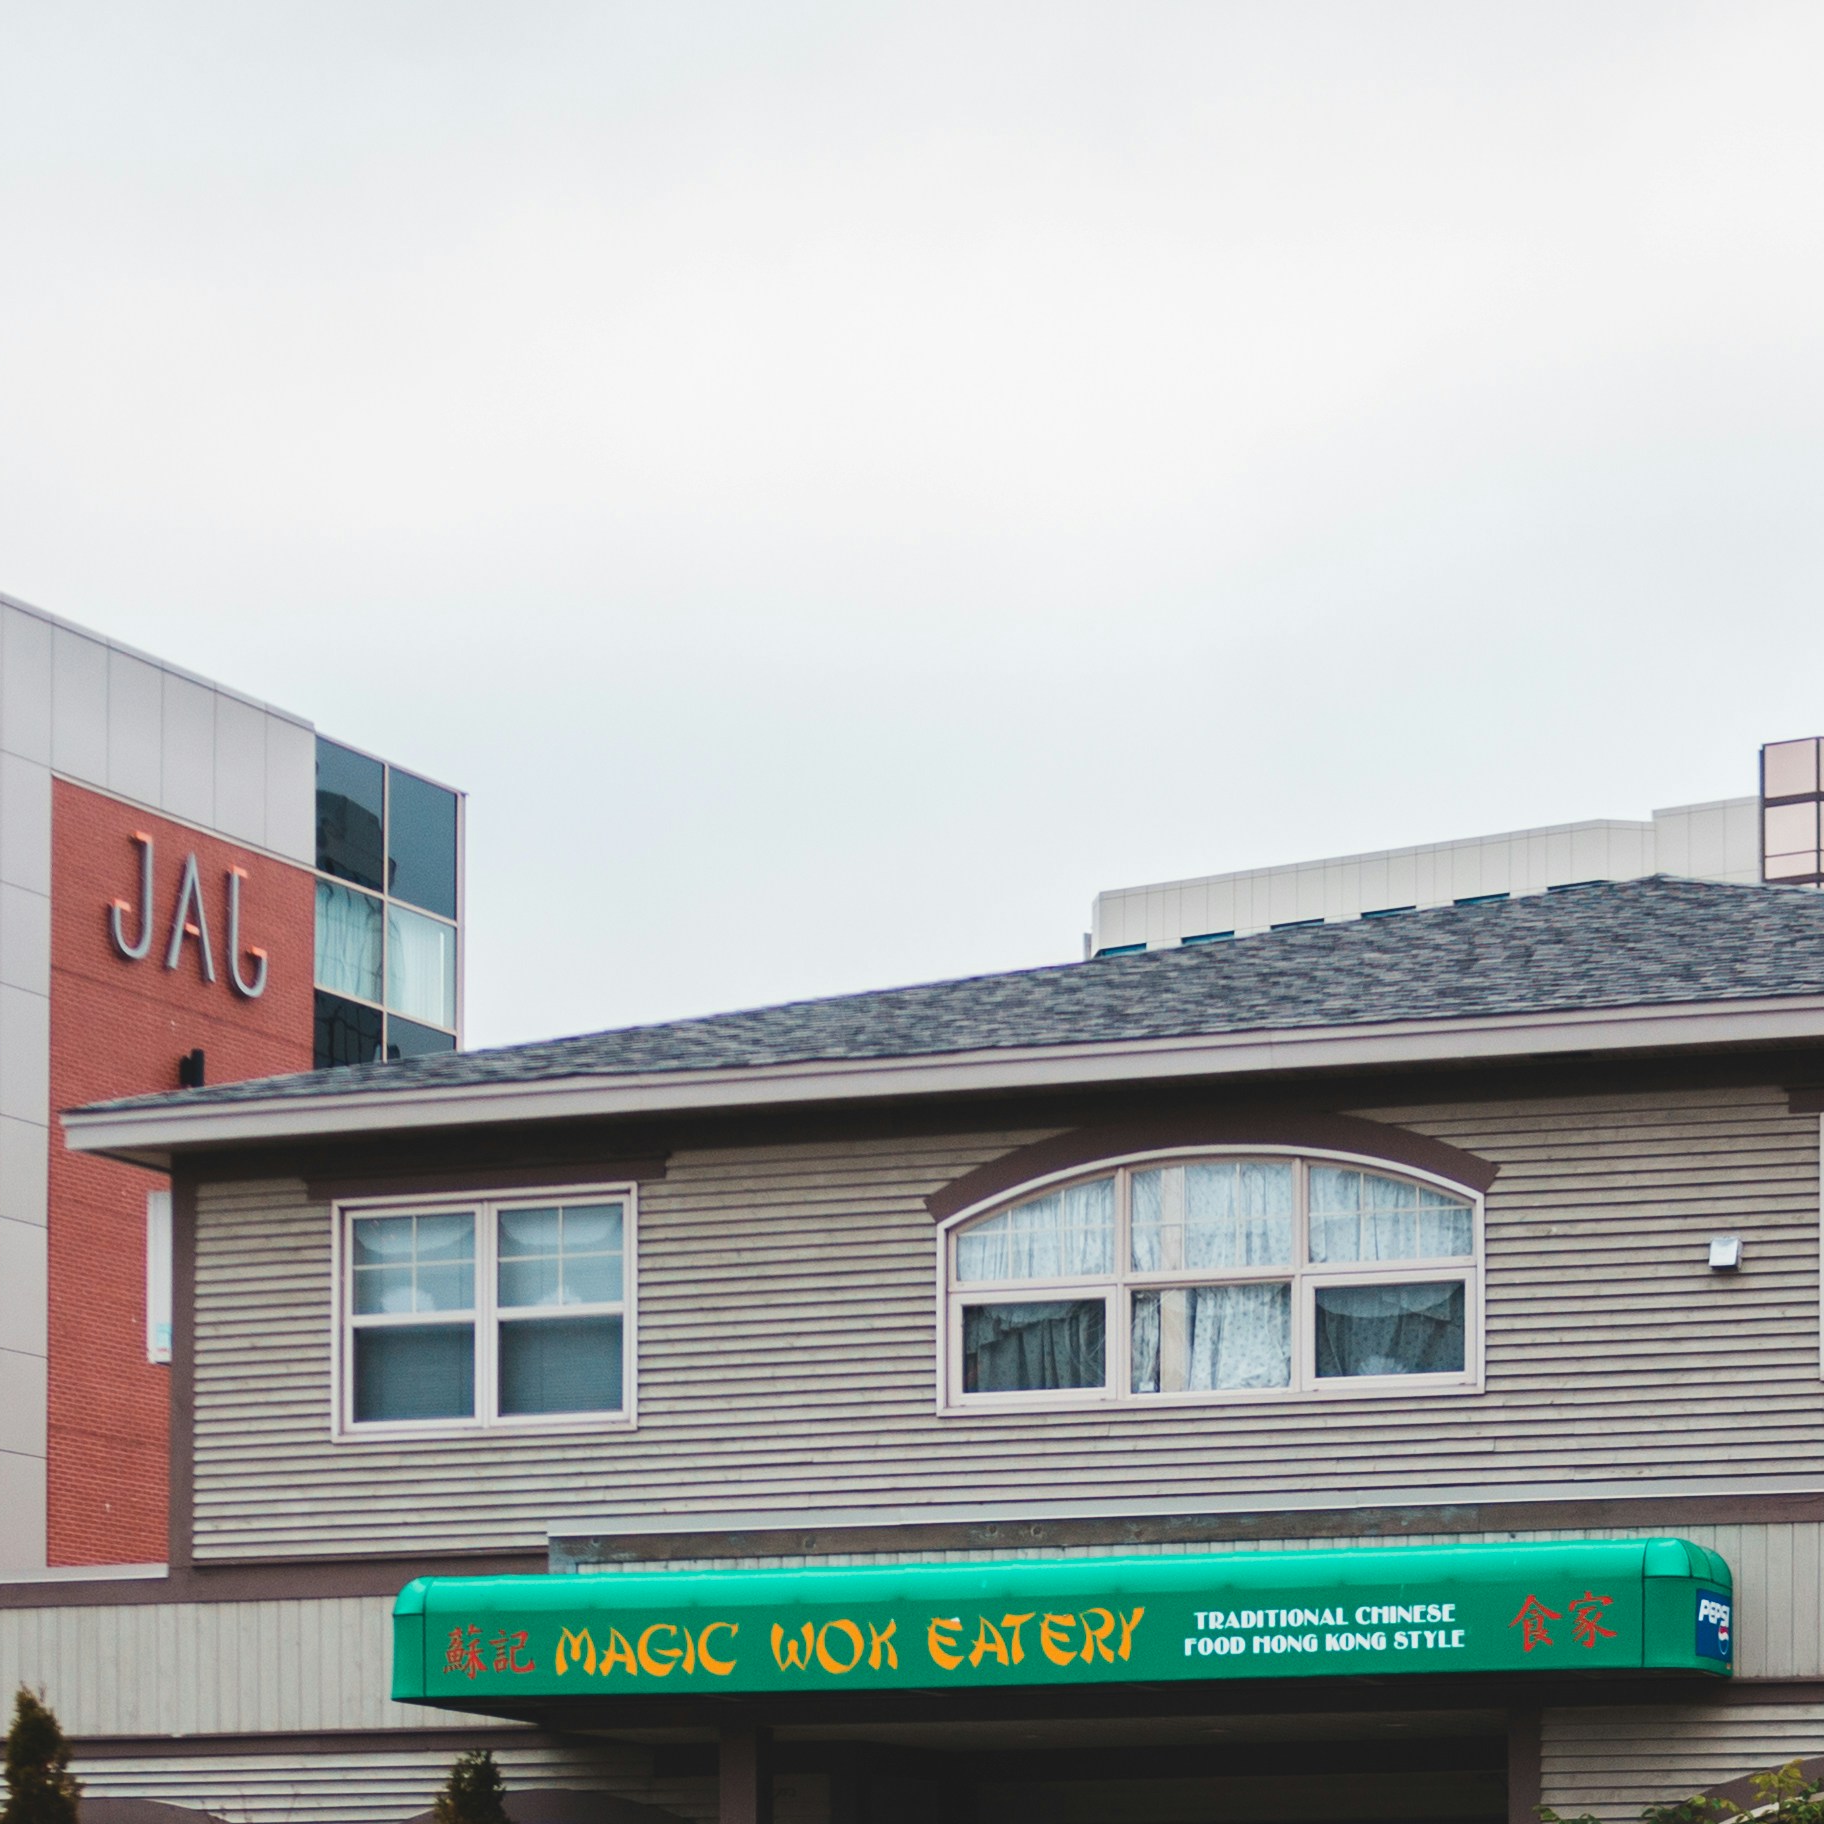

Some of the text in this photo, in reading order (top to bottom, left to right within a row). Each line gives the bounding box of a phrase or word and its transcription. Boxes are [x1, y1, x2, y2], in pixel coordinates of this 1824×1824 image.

[555, 1606, 1145, 1677] MAGIC WOK EATERY
[1184, 1629, 1465, 1656] FOOD HONG KONG STYLE
[1194, 1603, 1456, 1630] TRADITIONAL CHINESE
[1508, 1590, 1618, 1652] 食家
[443, 1623, 536, 1680] 蘇記
